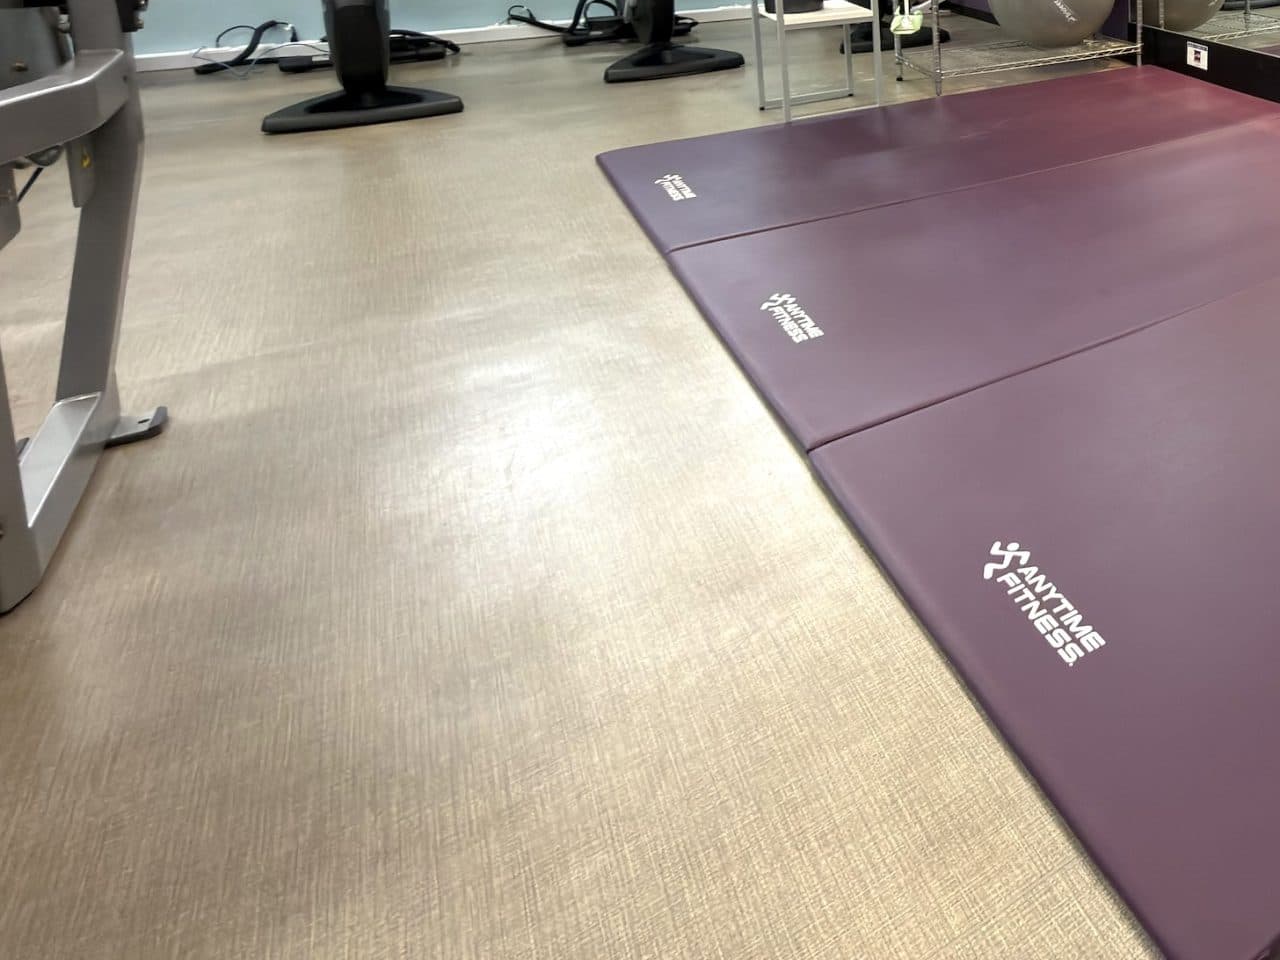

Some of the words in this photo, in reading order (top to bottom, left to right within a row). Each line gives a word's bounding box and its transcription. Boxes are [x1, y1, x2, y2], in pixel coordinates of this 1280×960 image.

[768, 305, 809, 343] FITNESS
[783, 303, 825, 339] ANYTIME
[996, 572, 1085, 664] FITNESS
[1017, 566, 1106, 653] ANYTIME
